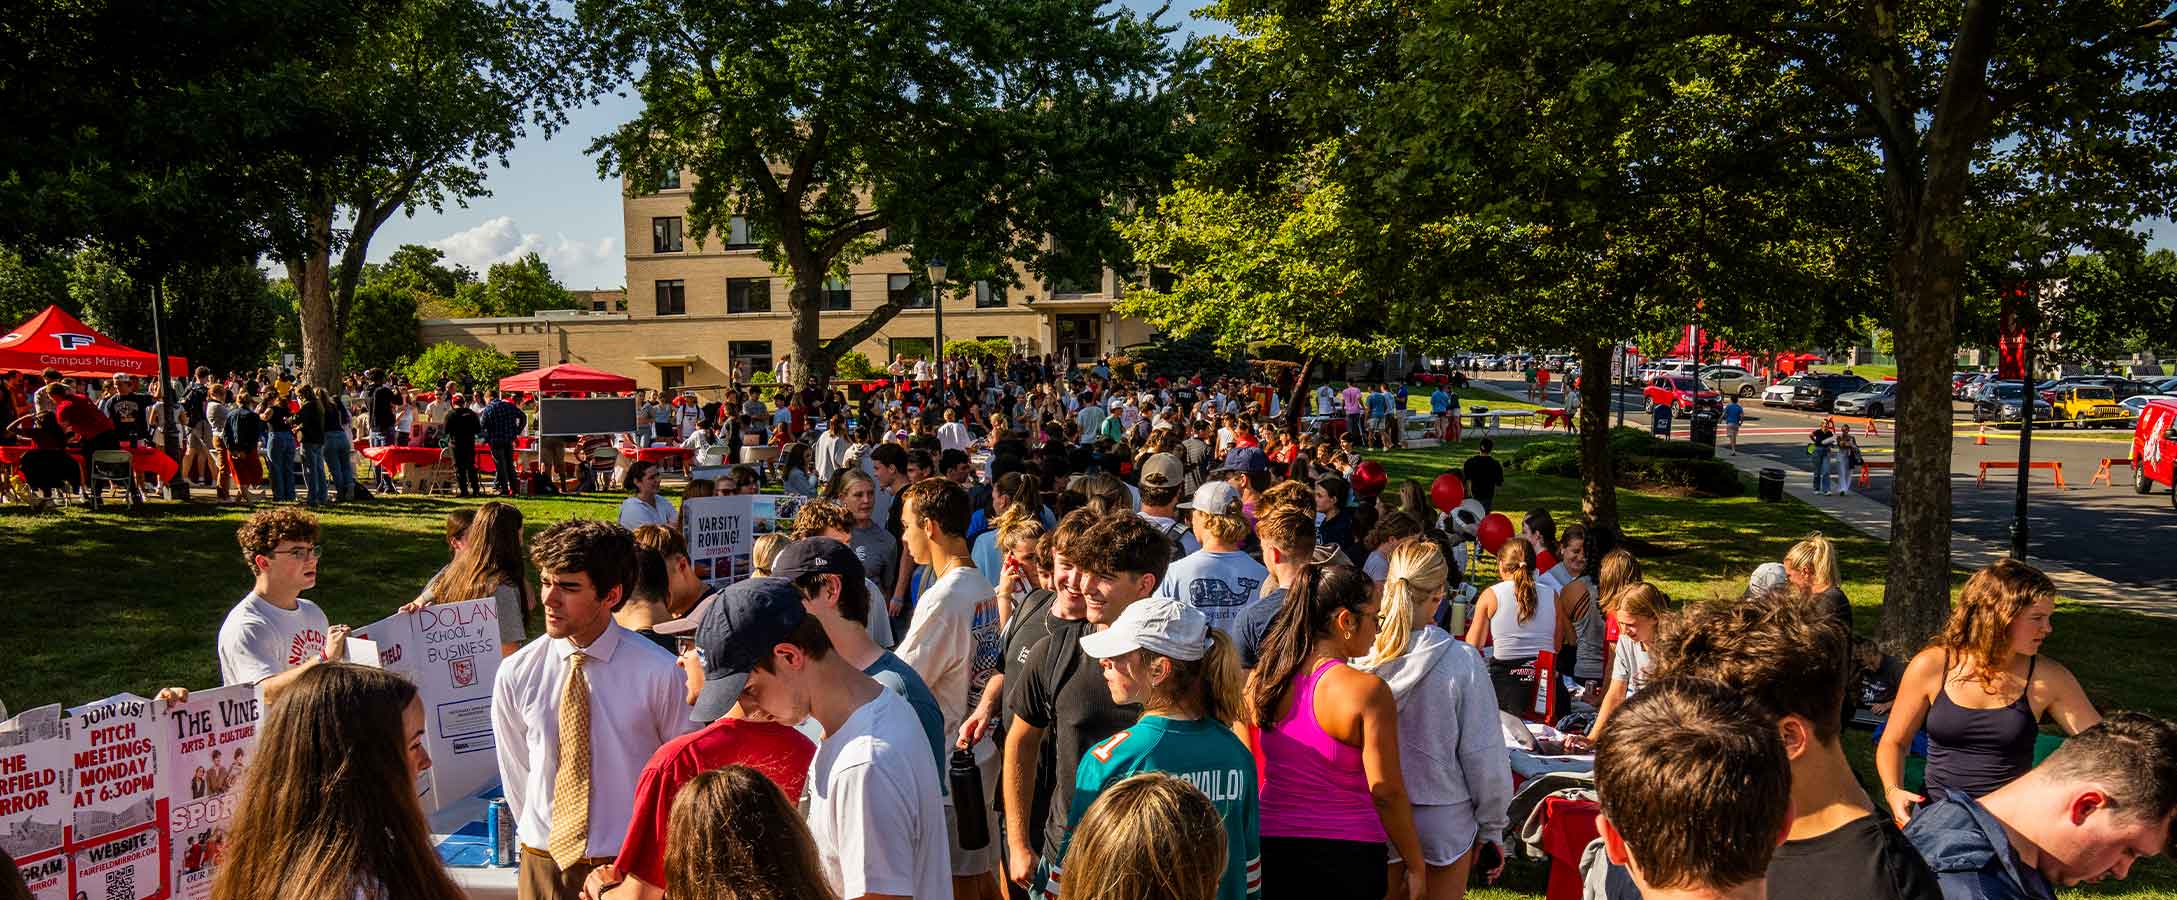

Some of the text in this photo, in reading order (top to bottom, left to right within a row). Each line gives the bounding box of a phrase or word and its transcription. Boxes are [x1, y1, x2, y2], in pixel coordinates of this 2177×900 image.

[40, 354, 143, 369] Campus Ministry
[698, 515, 740, 532] VARSITY
[698, 529, 739, 548] ROWING!
[419, 603, 497, 632] DOLAN
[425, 626, 471, 644] SCHOOL
[427, 638, 493, 663] BUSINESS
[81, 704, 116, 729] JOIN
[120, 701, 145, 718] US!
[90, 722, 136, 746] PITCH
[181, 725, 255, 754] ARTS & CULTURE
[1091, 731, 1131, 762] 1
[74, 738, 152, 769] MEETINGS
[80, 757, 148, 787] MONDAY
[1170, 769, 1243, 802] VAILO
[73, 789, 95, 808] AT
[99, 774, 154, 801] 6:30PM
[172, 790, 241, 833] SPOR
[79, 846, 157, 878] FAIRFIELDMIRROR.COM
[89, 833, 148, 863] WEBSITE
